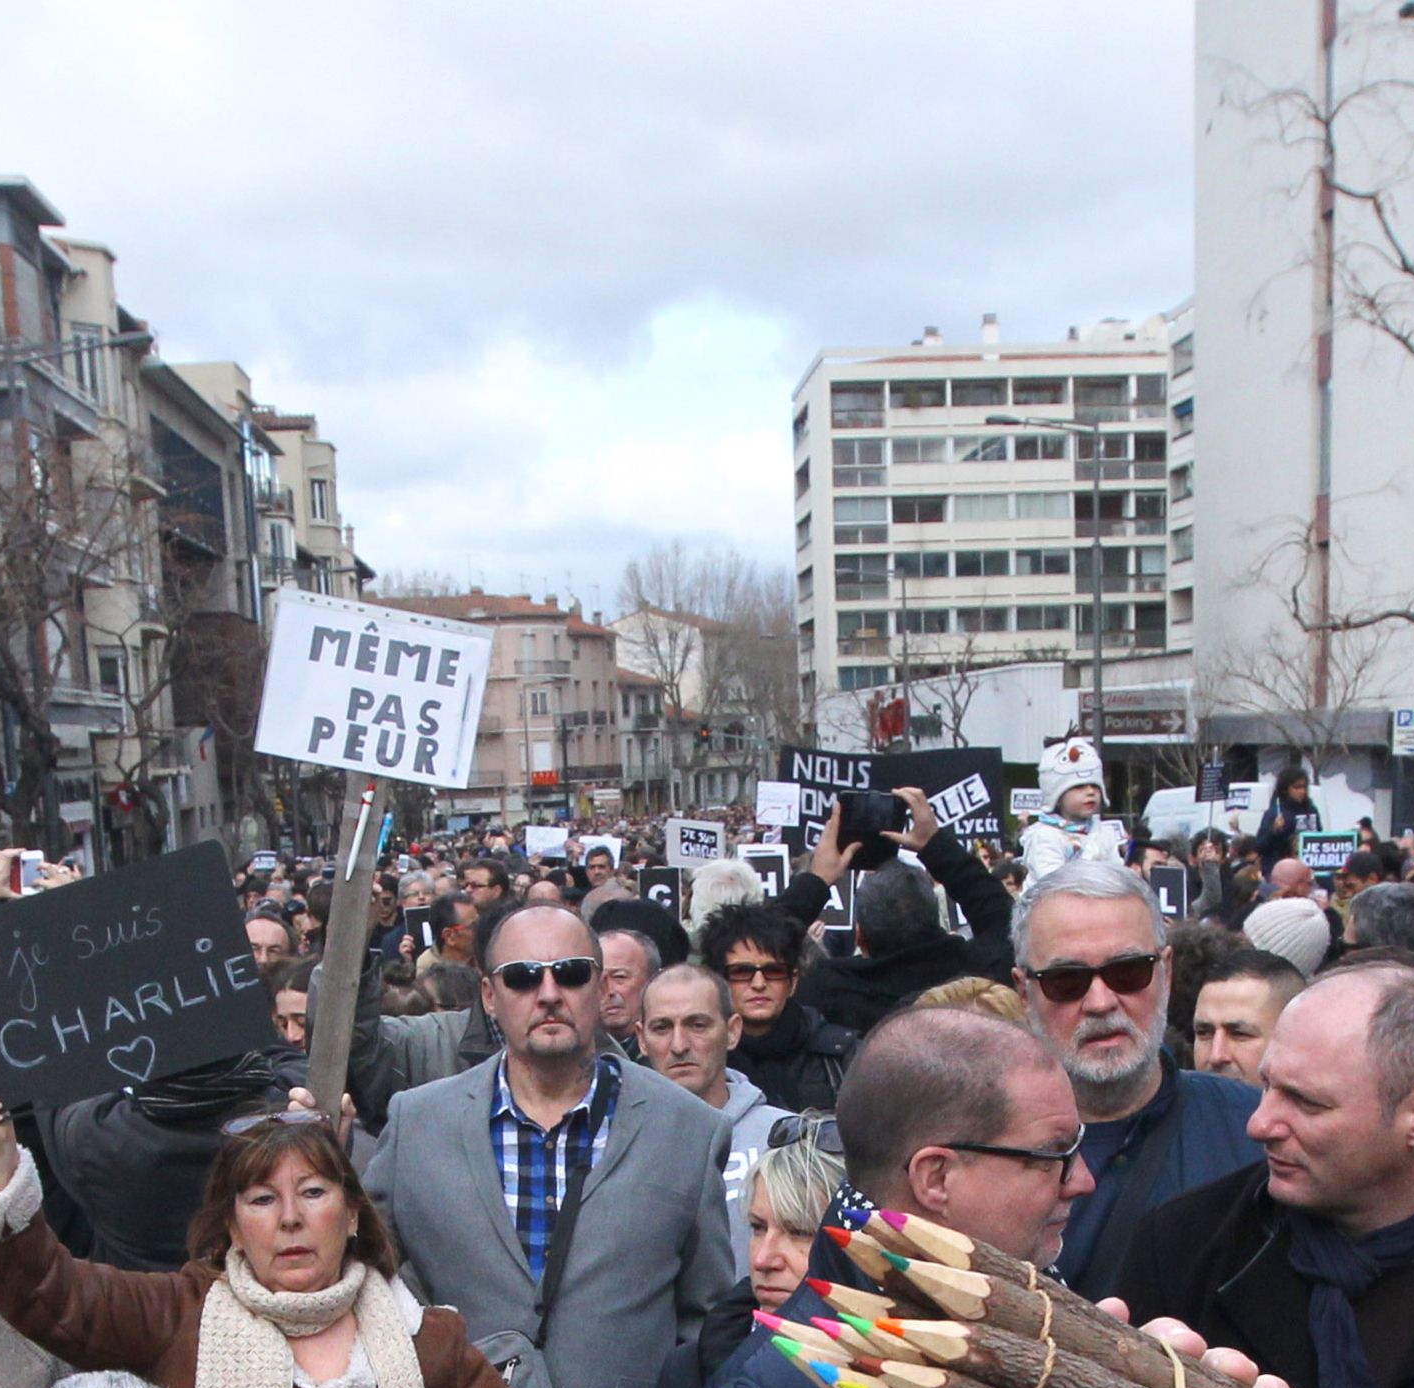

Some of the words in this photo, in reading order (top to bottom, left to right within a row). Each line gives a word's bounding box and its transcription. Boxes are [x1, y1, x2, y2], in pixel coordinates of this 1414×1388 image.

[308, 621, 461, 688] MÊME
[346, 687, 442, 737] PAS
[307, 716, 440, 776] PEUR
[792, 752, 872, 789] NOUS
[1303, 842, 1321, 853] JE
[1322, 841, 1354, 852] SUIS
[8, 930, 50, 1012] je
